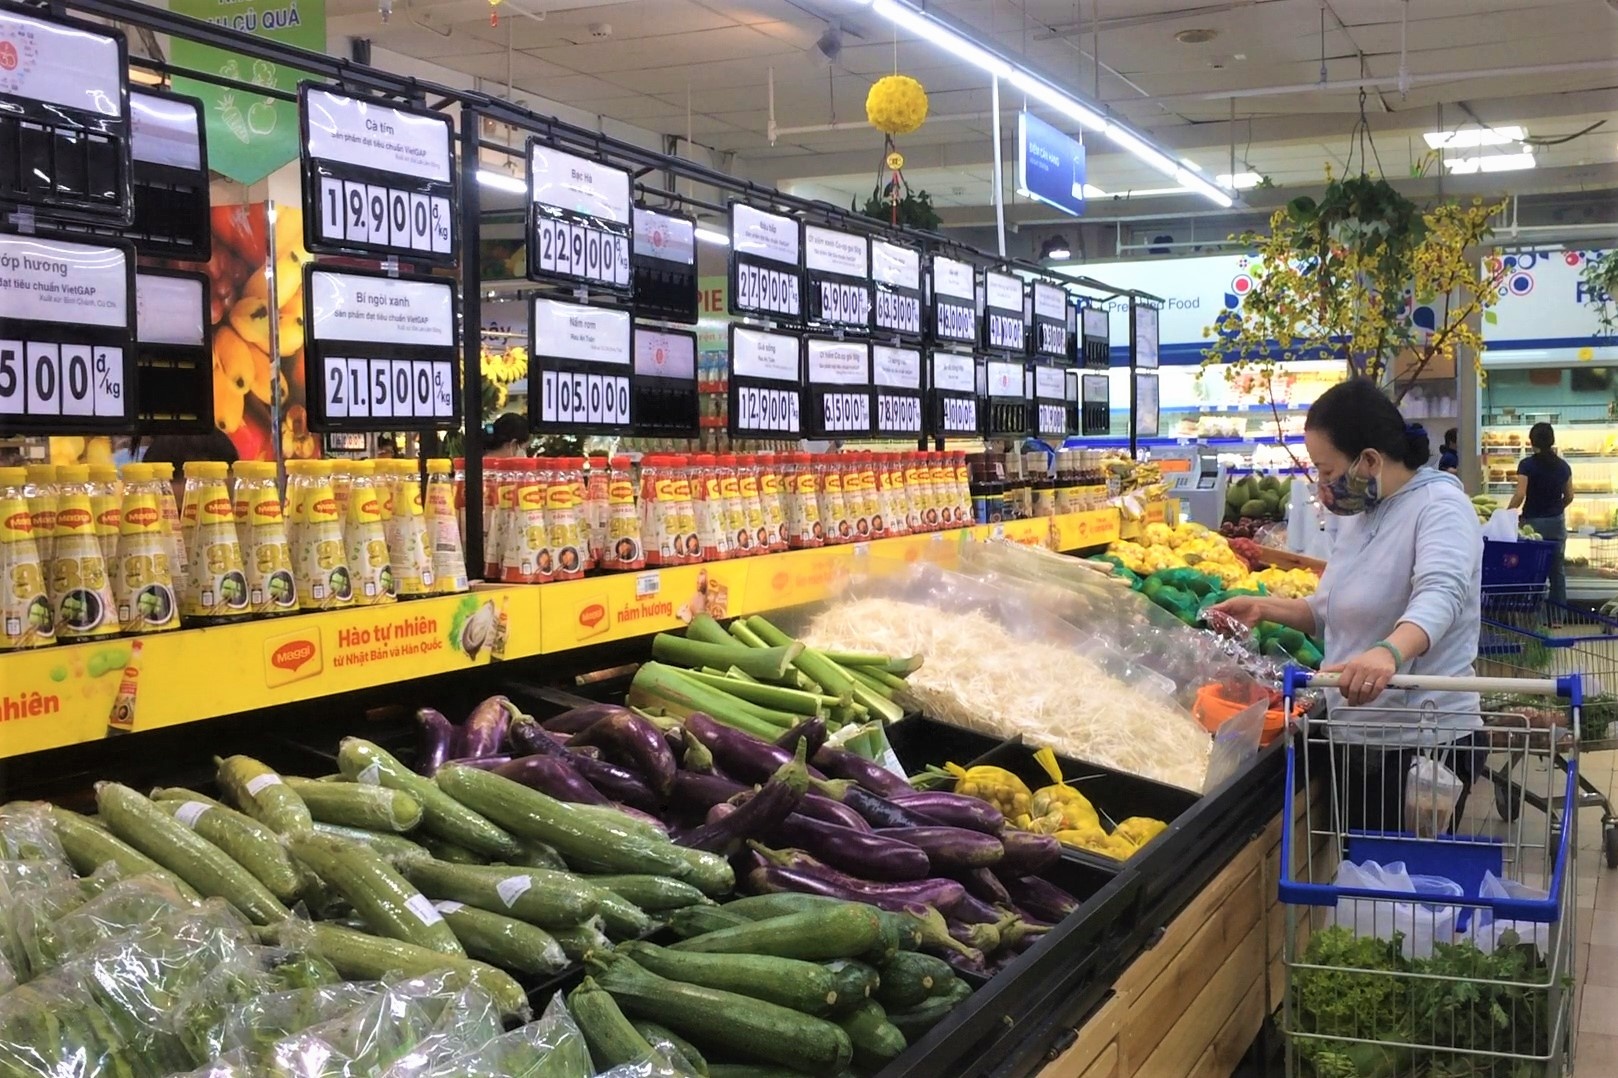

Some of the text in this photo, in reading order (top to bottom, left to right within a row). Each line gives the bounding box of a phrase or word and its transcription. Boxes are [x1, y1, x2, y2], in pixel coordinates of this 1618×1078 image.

[263, 2, 300, 30] QUẢ
[365, 119, 394, 135] Cà tím
[328, 188, 427, 237] 19.900
[0, 252, 20, 272] ớp
[543, 228, 613, 270] 22.900
[14, 279, 31, 290] tiêu
[33, 281, 60, 293] chuẩn
[61, 284, 97, 297] VietGAP
[356, 291, 367, 304] Bí
[389, 296, 411, 308] xanh
[740, 270, 788, 305] 27.900
[1168, 296, 1201, 310] Food
[330, 367, 431, 406] 21.500
[547, 378, 628, 416] 105.000
[742, 392, 788, 423] 12.900
[825, 397, 860, 423] 6.500
[617, 601, 673, 622] nấm hương
[338, 615, 437, 649] Hào tự nhiên
[276, 645, 311, 664] Maggi
[346, 650, 369, 667] Nhật
[370, 647, 388, 661] Bản
[390, 648, 400, 658] và
[401, 643, 419, 656] Hàn
[420, 637, 443, 654] Quốc
